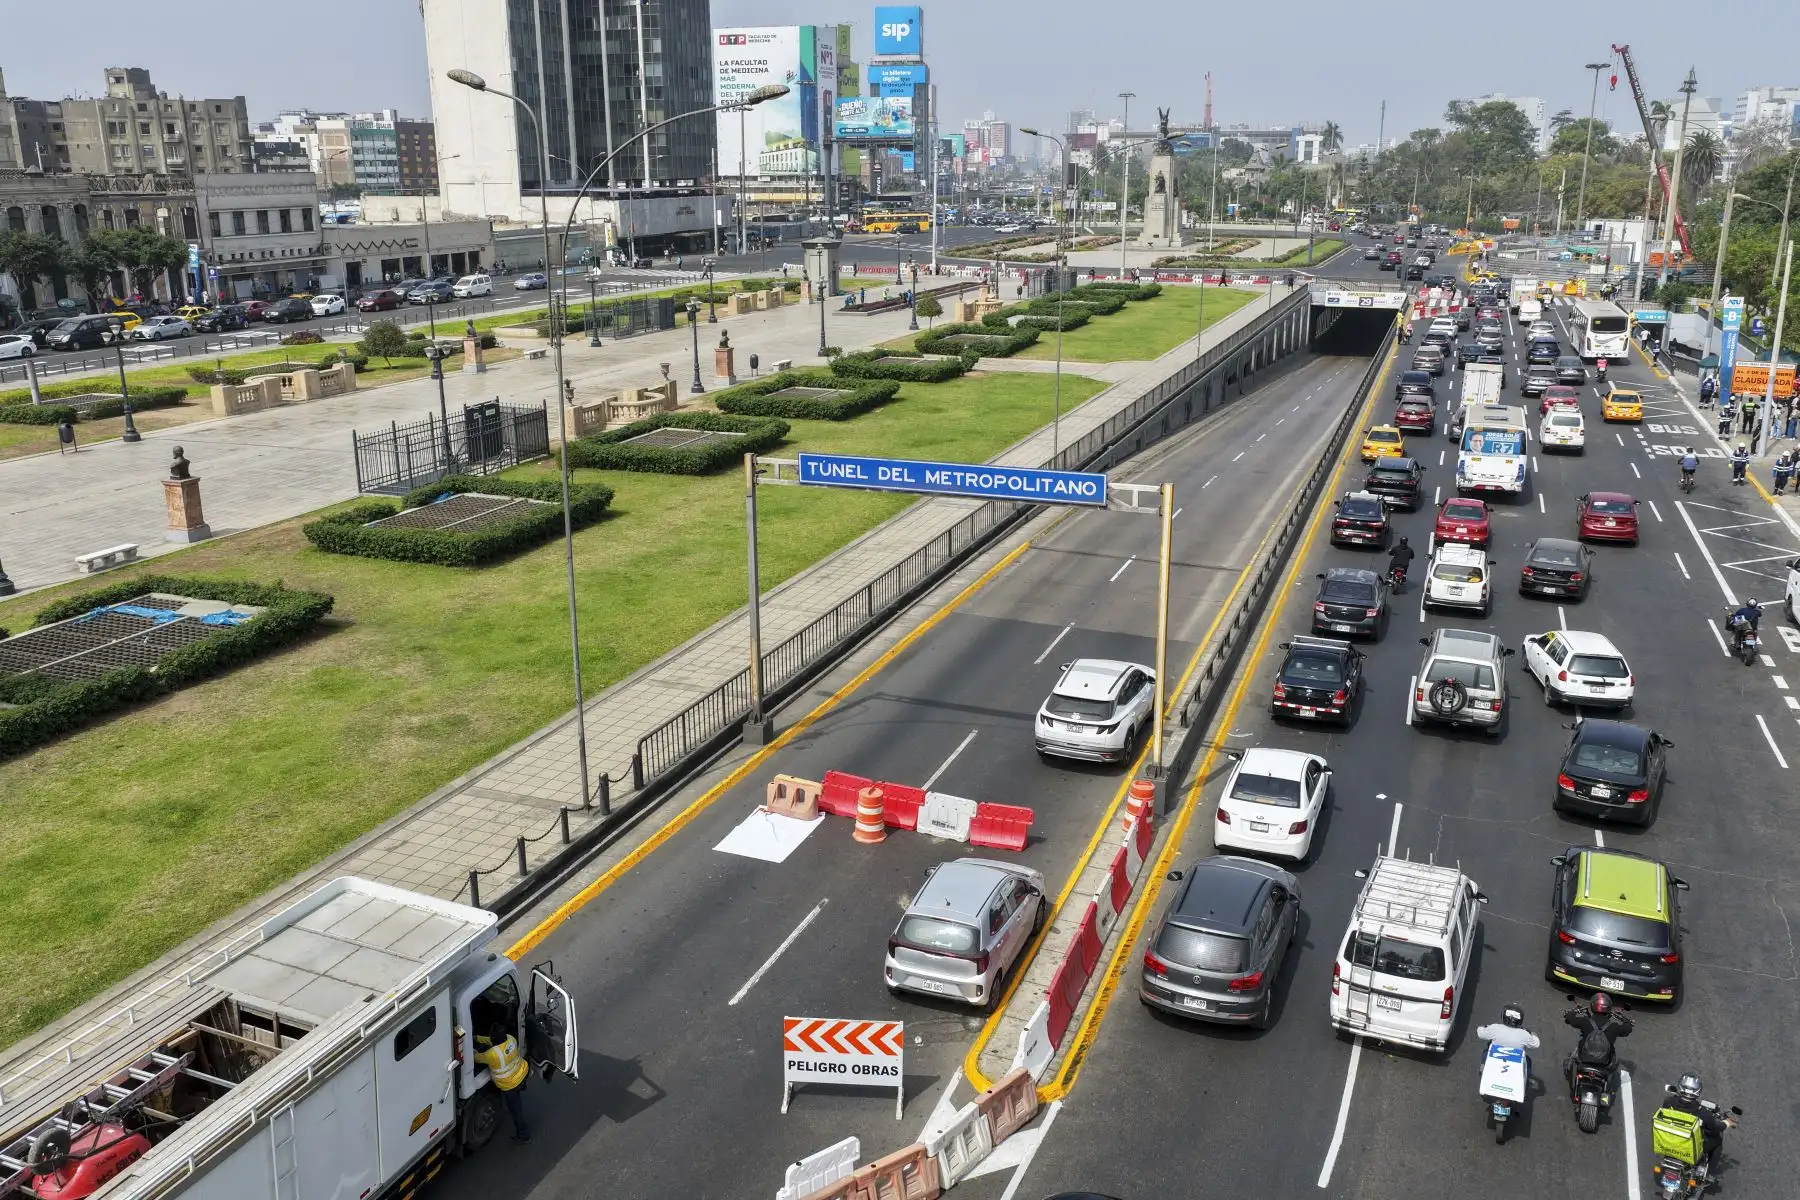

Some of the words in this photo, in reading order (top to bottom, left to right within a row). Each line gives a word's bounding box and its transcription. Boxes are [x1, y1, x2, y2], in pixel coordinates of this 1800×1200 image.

[720, 35, 745, 44] UTP
[1360, 298, 1372, 306] 29
[1728, 311, 1737, 322] B
[1734, 375, 1792, 387] CLAUSUADA
[1647, 423, 1700, 435] BUS
[807, 460, 869, 480] TÚNEL
[878, 466, 916, 484] DEL
[925, 469, 1098, 497] METROPOLITANO
[788, 1060, 848, 1074] PELIGRO
[851, 1063, 899, 1077] OBRAS
